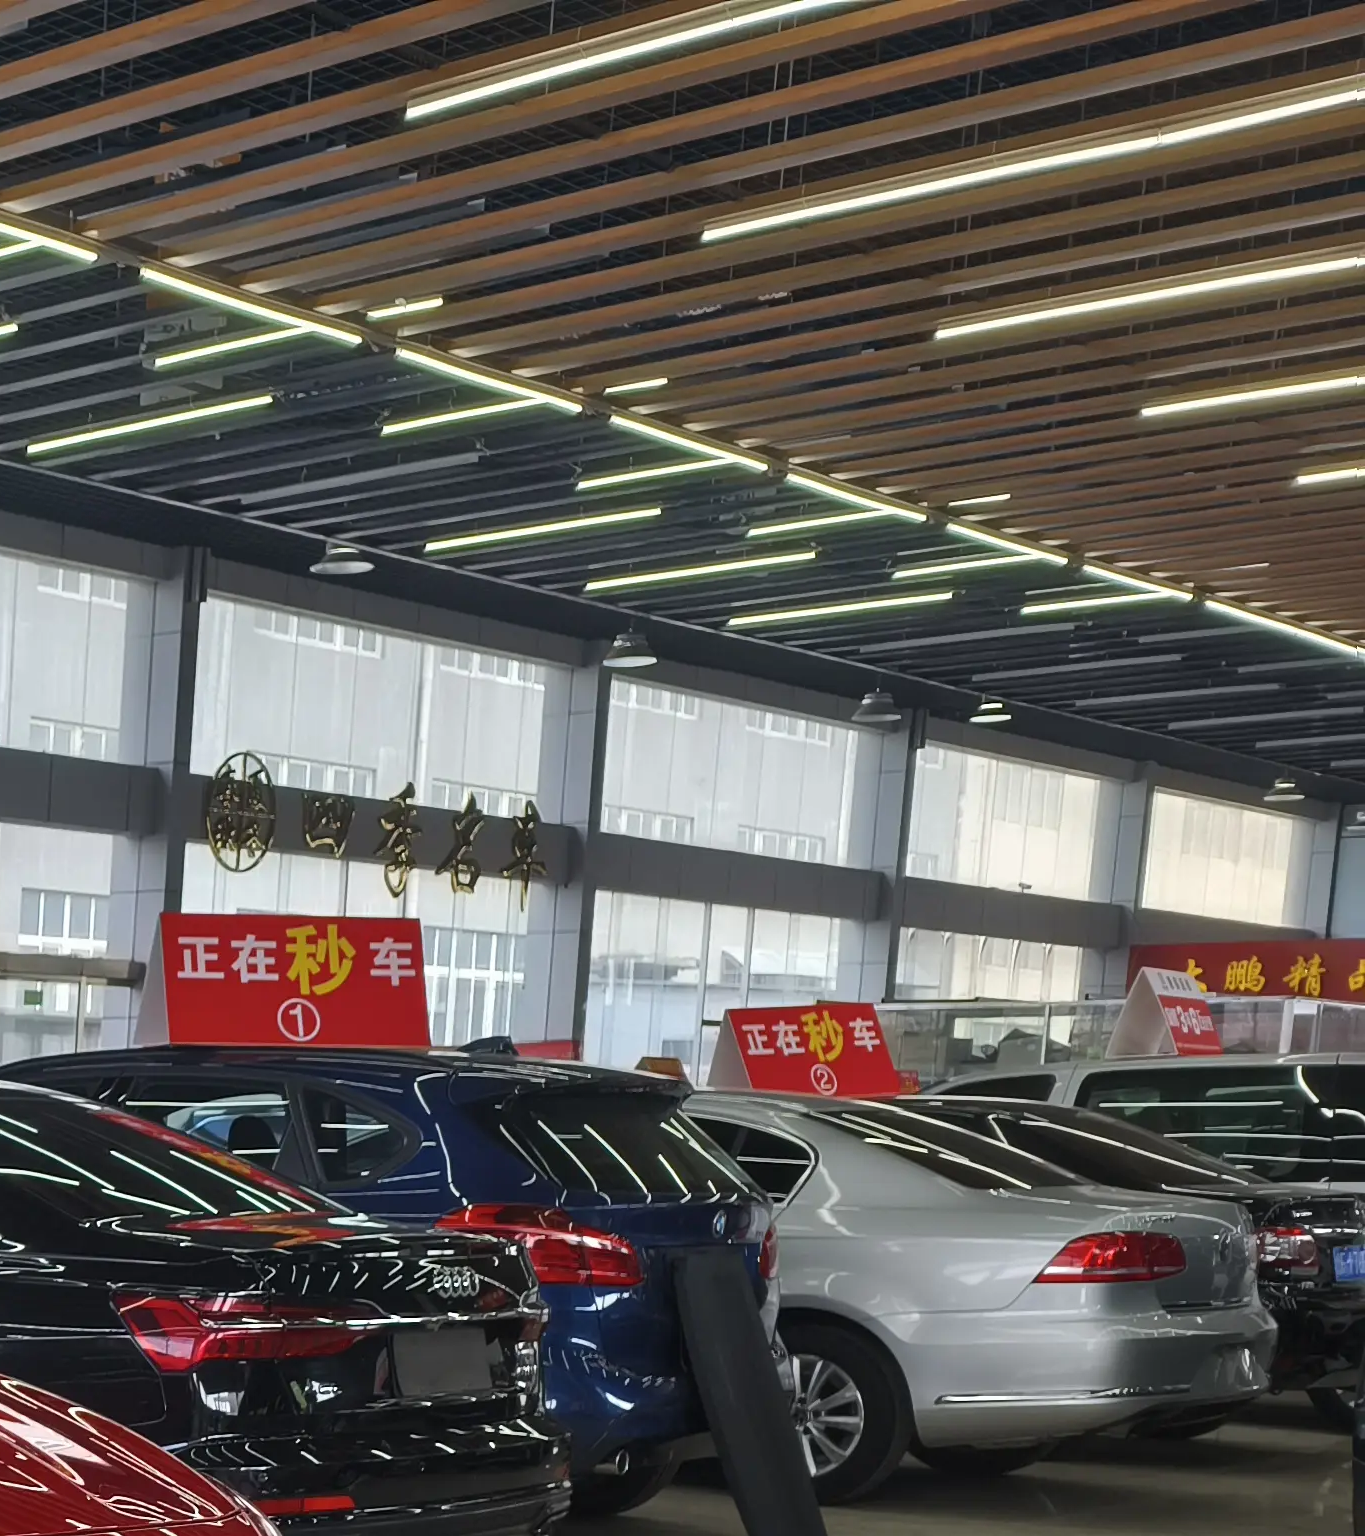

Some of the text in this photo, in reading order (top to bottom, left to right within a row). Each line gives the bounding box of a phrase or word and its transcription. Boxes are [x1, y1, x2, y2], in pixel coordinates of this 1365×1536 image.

[177, 924, 416, 996] 正在秒车
[742, 1010, 881, 1063] 正在秒车
